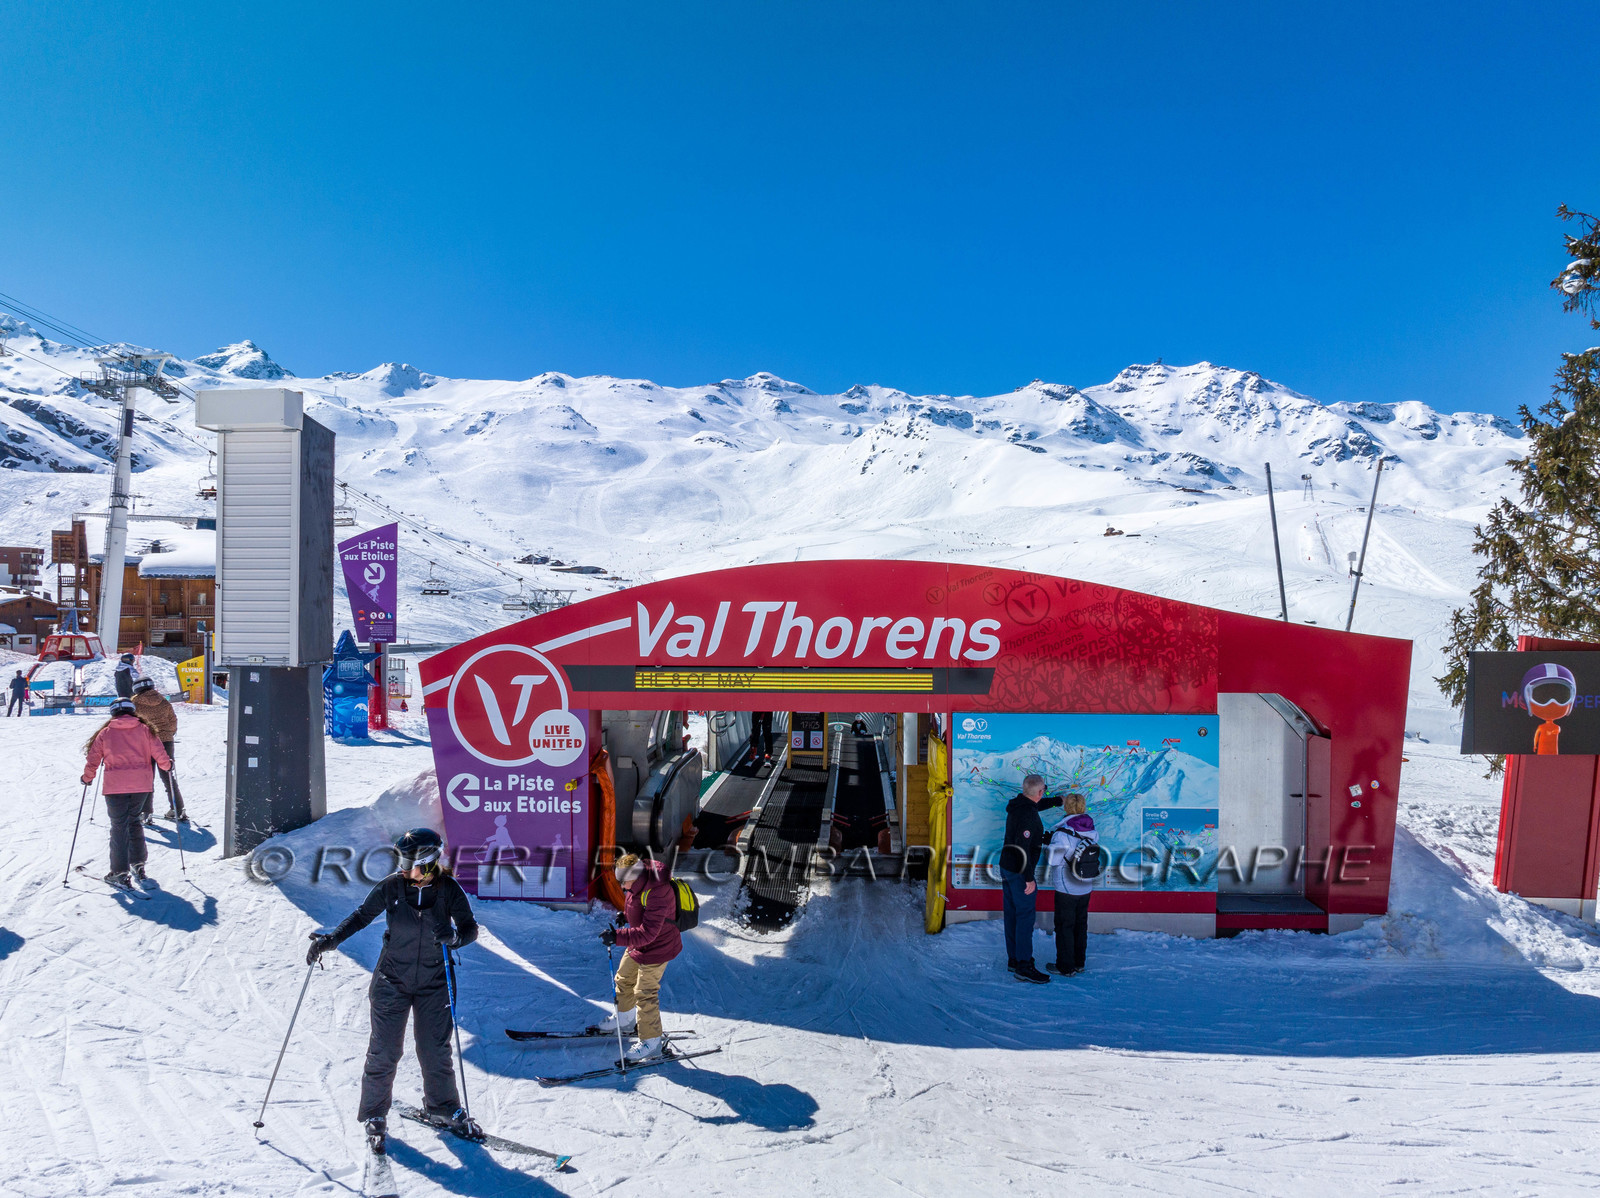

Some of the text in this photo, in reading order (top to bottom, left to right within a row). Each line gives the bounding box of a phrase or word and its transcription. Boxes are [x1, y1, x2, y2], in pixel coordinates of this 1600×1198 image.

[358, 539, 395, 550] La Piste
[344, 551, 395, 561] aux Etoiles
[637, 600, 1001, 661] Val Thorens
[671, 672, 680, 688] 8
[687, 672, 712, 688] OF
[717, 673, 756, 688] MAY
[544, 725, 570, 735] LIVE
[532, 738, 583, 749] UNITED
[484, 774, 555, 792] La Piste
[483, 795, 582, 814] aux Etoiles
